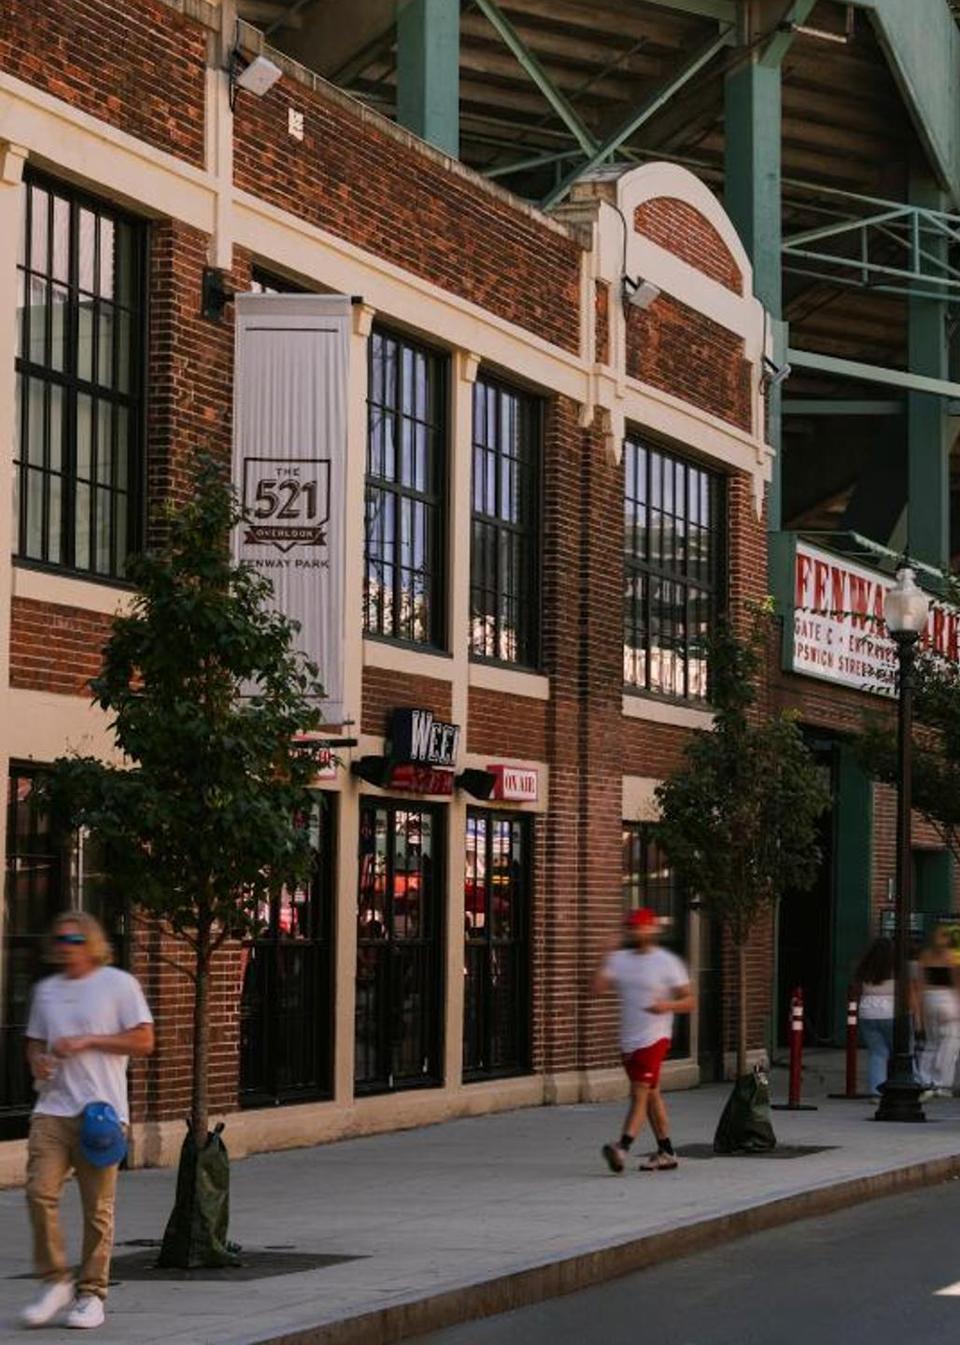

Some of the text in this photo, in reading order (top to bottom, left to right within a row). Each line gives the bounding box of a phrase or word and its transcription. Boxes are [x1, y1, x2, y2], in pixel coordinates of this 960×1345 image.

[275, 467, 300, 476] THE
[254, 479, 318, 520] 521
[295, 559, 329, 569] PARK
[796, 553, 895, 640] FENWA
